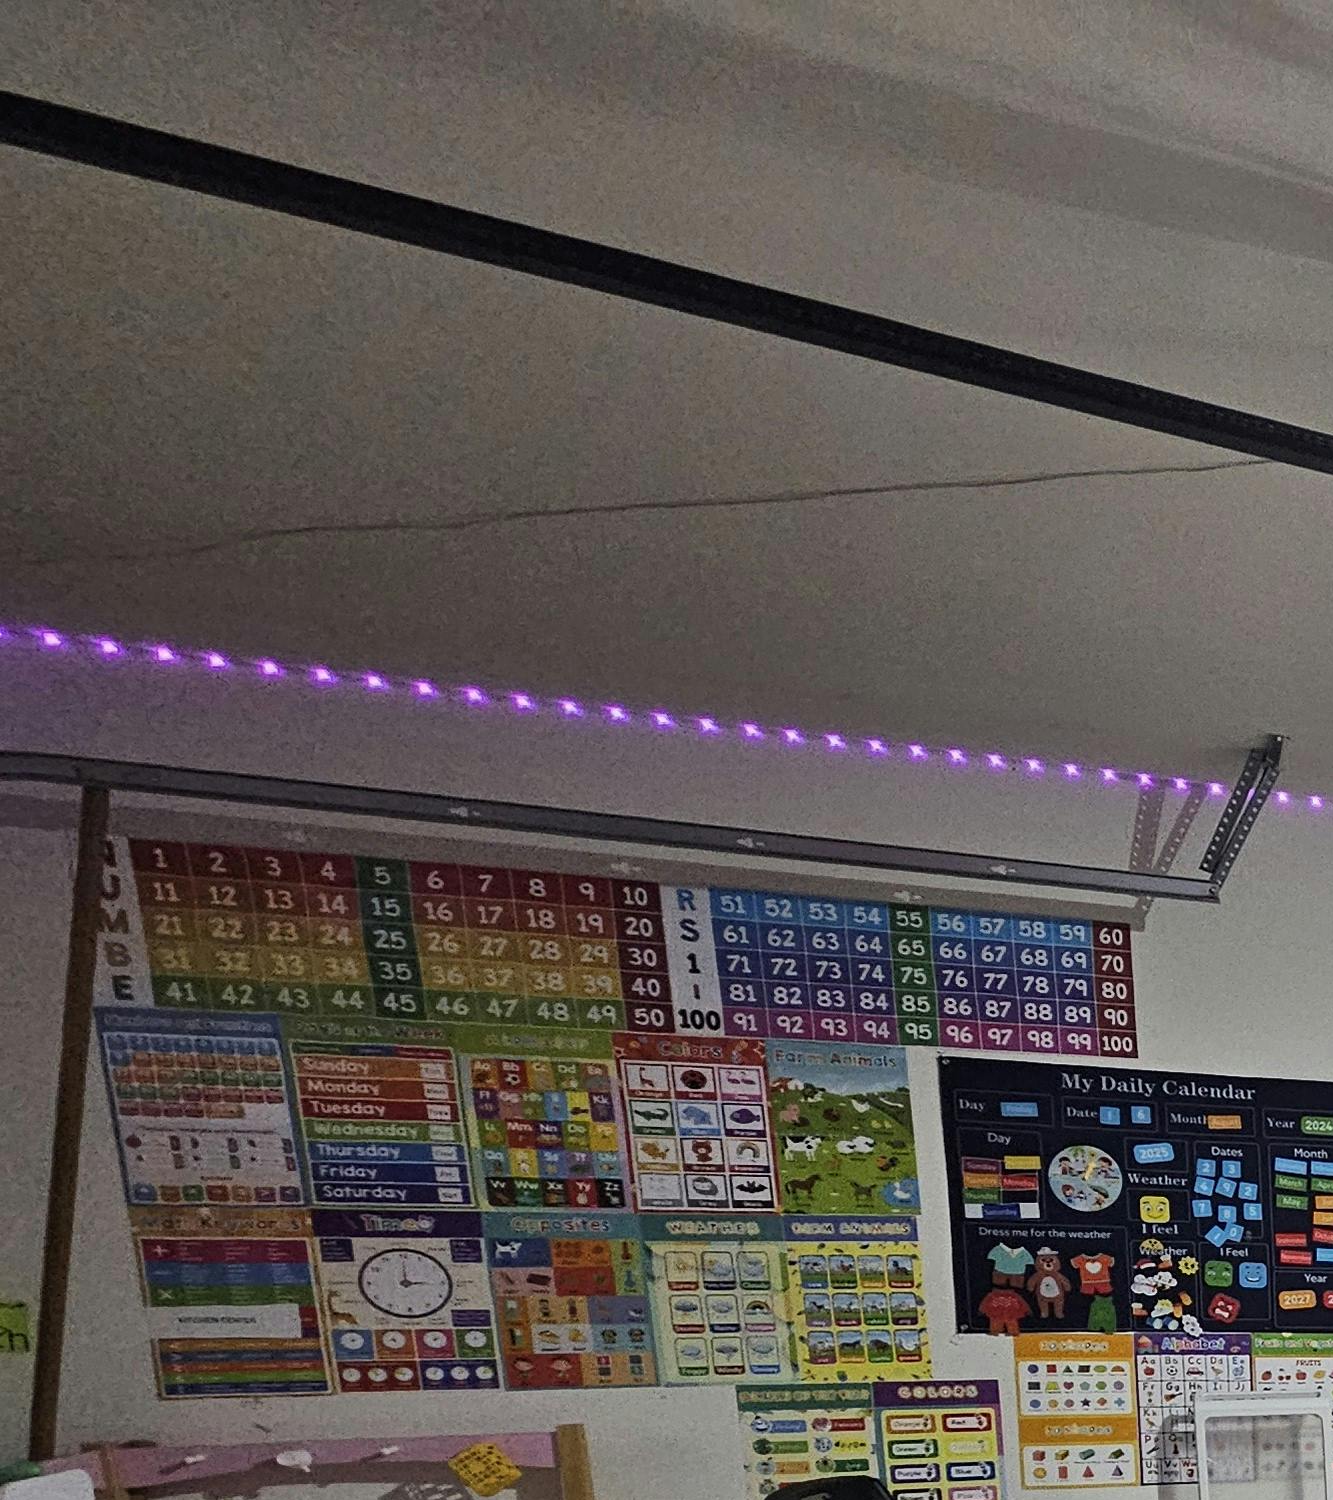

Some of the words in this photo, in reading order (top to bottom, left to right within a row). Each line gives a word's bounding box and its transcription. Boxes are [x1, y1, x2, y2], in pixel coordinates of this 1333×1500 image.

[733, 1013, 757, 1032] 91
[777, 1016, 804, 1033] 92
[821, 1019, 848, 1036] 93
[863, 1021, 890, 1038] 94
[905, 1023, 932, 1040] 95
[946, 1025, 973, 1043] 96
[988, 1028, 1013, 1046] 97
[1028, 1030, 1053, 1048] 98
[1067, 1033, 1091, 1050] 99
[1103, 1036, 1132, 1052] 100
[658, 1040, 723, 1059] Colors
[302, 1058, 369, 1075] Sunday
[830, 1052, 896, 1067] Animals
[307, 1080, 381, 1096] Monday
[1062, 1073, 1093, 1093] My
[1101, 1075, 1155, 1097] Daily
[1163, 1080, 1256, 1100] Calendar
[310, 1101, 385, 1116] Tuesday
[959, 1099, 986, 1112] Day
[1067, 1107, 1098, 1118] Date
[314, 1122, 418, 1138] Wednesday
[1267, 1118, 1295, 1128] Year
[1305, 1120, 1333, 1132] 2024
[987, 1132, 1011, 1145] Day
[316, 1144, 401, 1159] Thursday
[1212, 1147, 1243, 1157] Dates
[1294, 1148, 1328, 1159] Month
[319, 1165, 377, 1179] Friday
[1128, 1173, 1188, 1186] Weather
[323, 1185, 407, 1200] Saturday
[512, 1217, 610, 1233] Opposites
[1142, 1224, 1146, 1234] I
[1148, 1224, 1179, 1234] feel
[979, 1227, 1008, 1237] Dress
[1030, 1228, 1045, 1238] for
[1047, 1229, 1067, 1238] the
[1068, 1230, 1112, 1239] weather
[1226, 1248, 1248, 1257] Feel
[1304, 1274, 1327, 1283] Year
[1285, 1295, 1311, 1305] 2027
[1161, 1337, 1225, 1351] Alphabet
